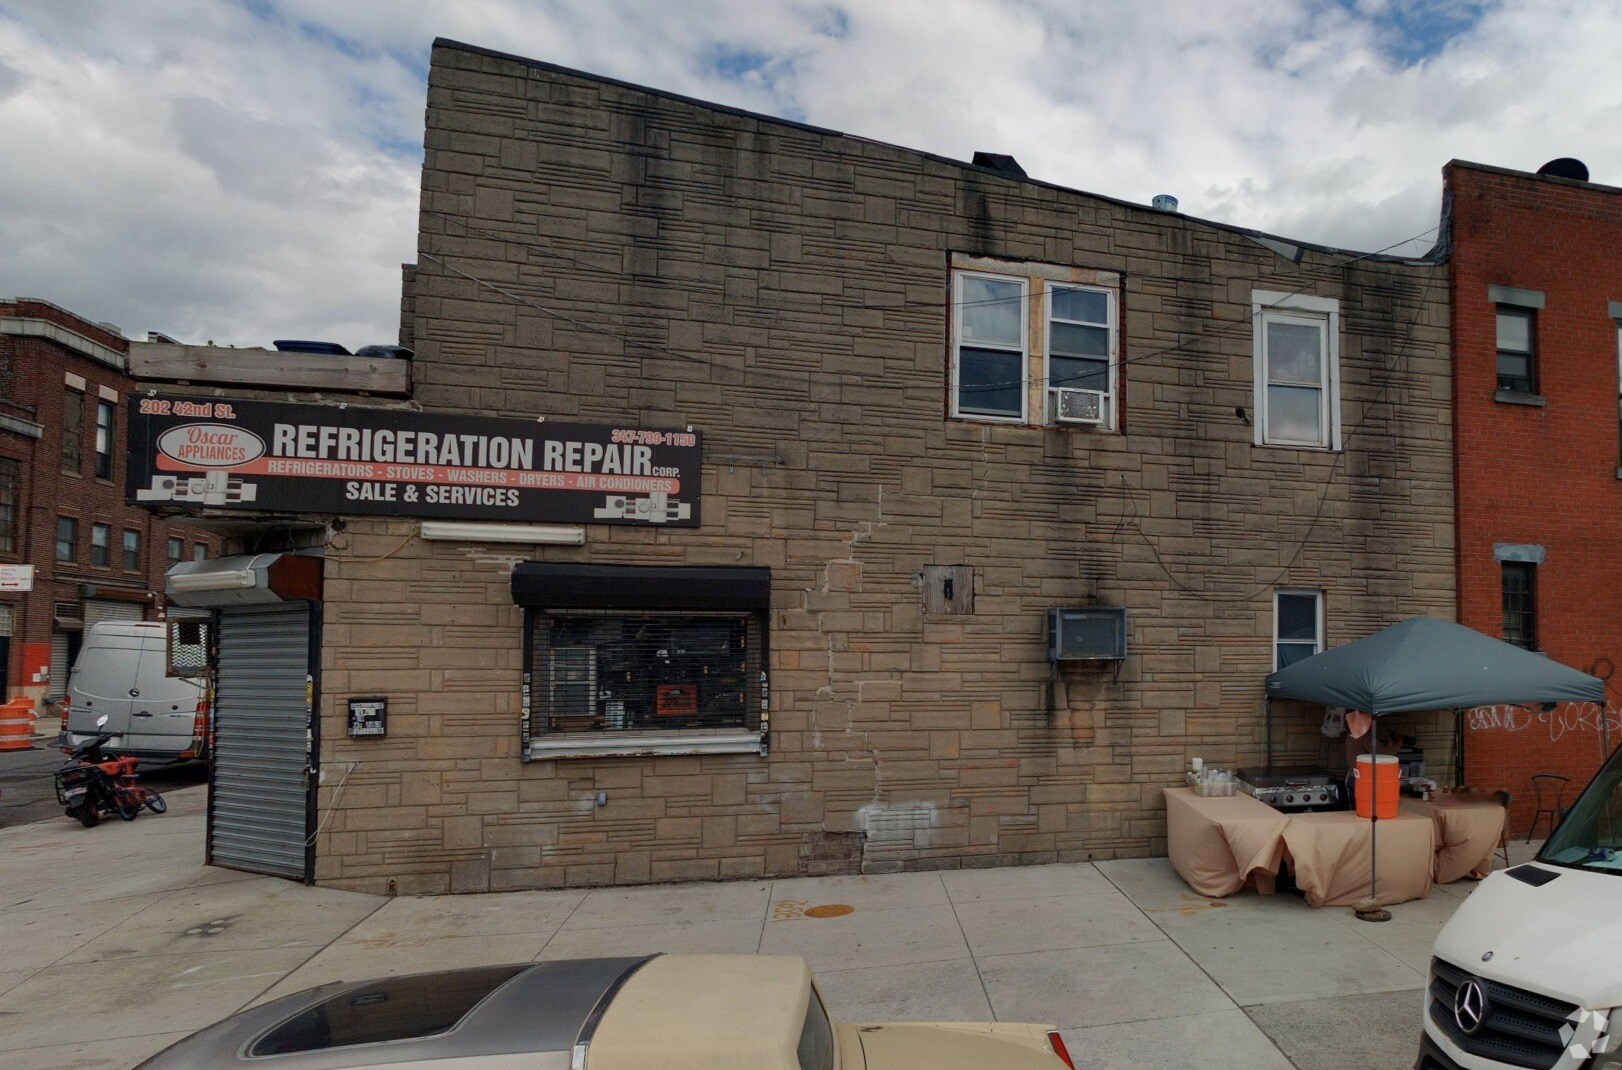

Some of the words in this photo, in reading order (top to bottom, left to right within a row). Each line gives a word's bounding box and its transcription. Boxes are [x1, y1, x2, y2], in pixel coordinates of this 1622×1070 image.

[140, 400, 170, 415] 202
[173, 401, 212, 417] 42nd
[214, 404, 236, 419] St.
[187, 427, 238, 446] Oscar
[611, 429, 696, 447] 347-799-1150
[178, 444, 246, 461] APPLIANCES
[273, 423, 533, 470] REFRIGERATION
[544, 440, 652, 476] REPAIR
[652, 466, 680, 477] CORP.
[267, 460, 374, 478] REFRIGERATORS
[386, 464, 435, 481] STOVES
[447, 469, 508, 484] WASHERS
[519, 475, 565, 488] DRYERS
[576, 476, 596, 488] AIR
[599, 478, 672, 492] CONDIONERS
[346, 482, 397, 502] SALE
[403, 485, 419, 503] &
[425, 486, 520, 507] SERVICES
